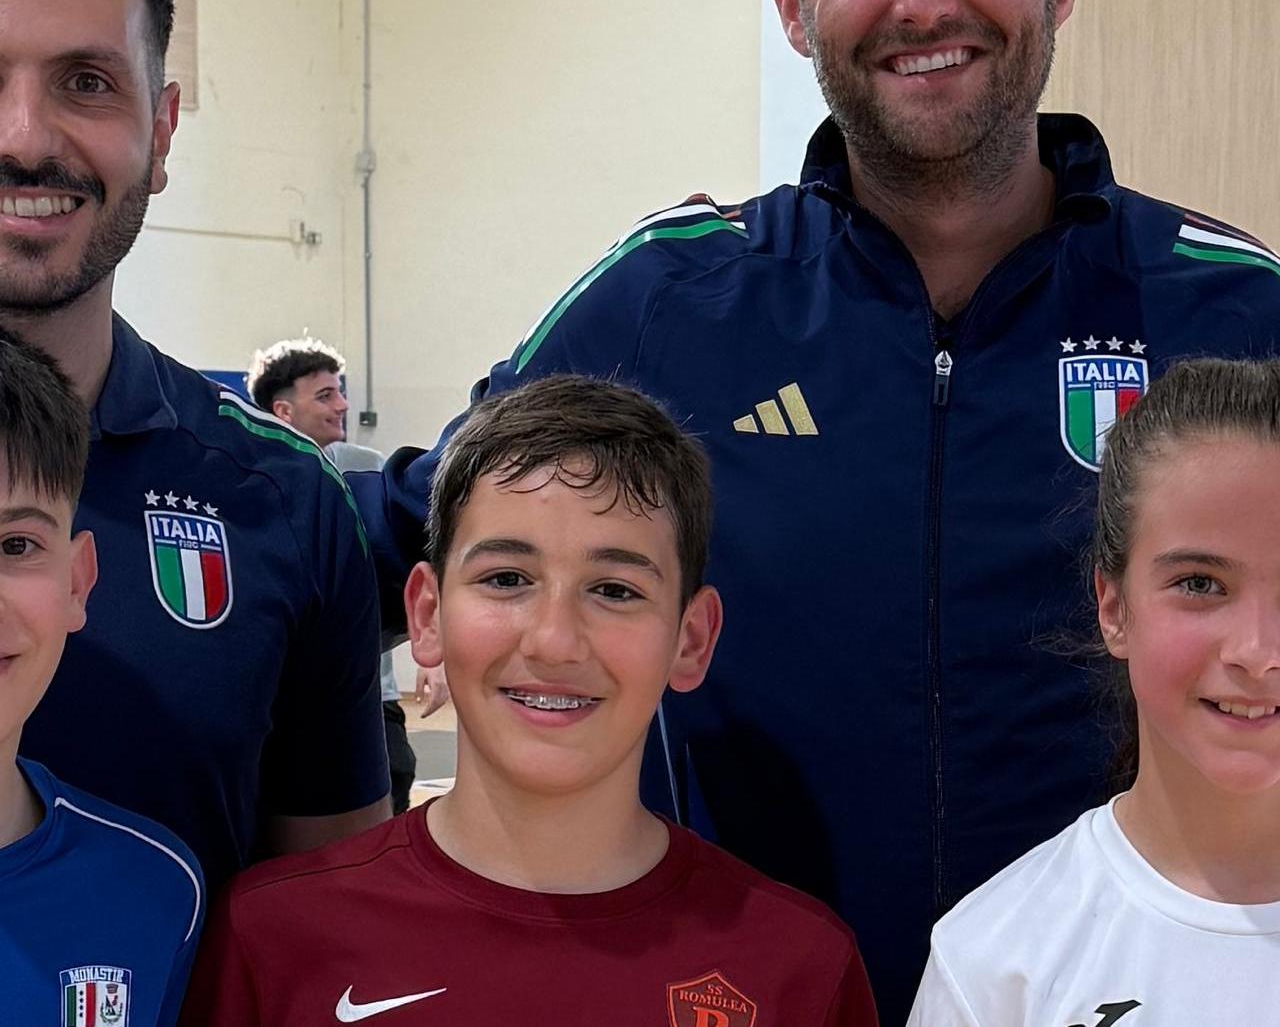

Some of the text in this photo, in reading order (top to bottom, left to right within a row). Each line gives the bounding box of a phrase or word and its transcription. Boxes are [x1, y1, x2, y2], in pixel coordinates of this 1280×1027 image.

[1065, 362, 1141, 383] ITALIA
[151, 516, 221, 545] ITALIA
[706, 983, 724, 996] SS
[679, 989, 748, 1013] ROMULEA
